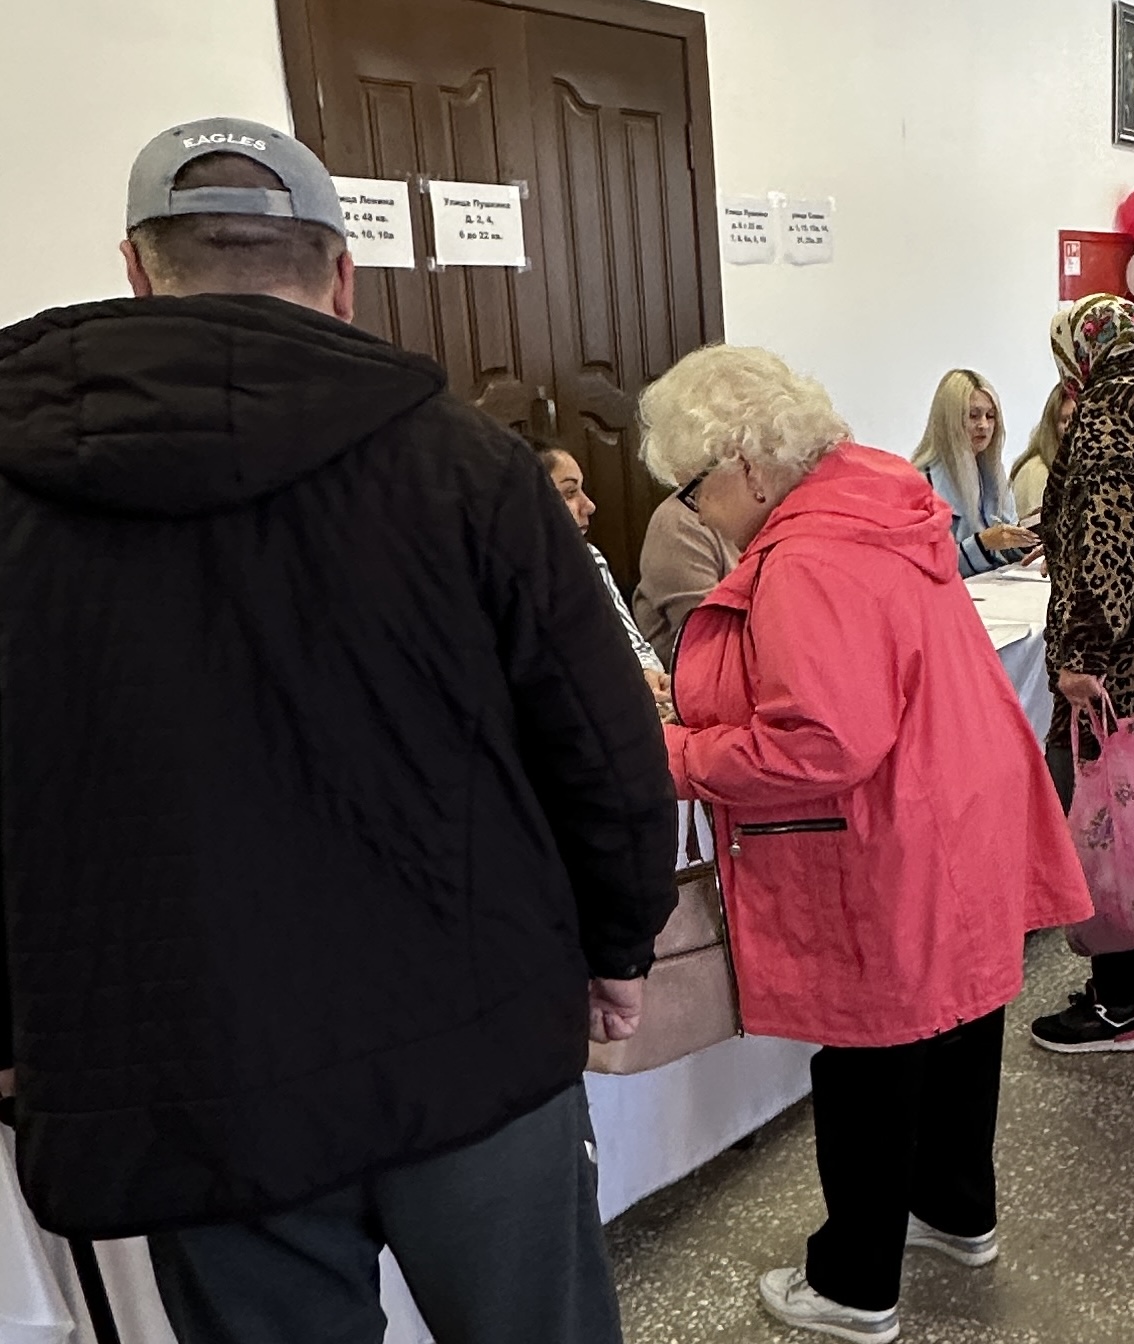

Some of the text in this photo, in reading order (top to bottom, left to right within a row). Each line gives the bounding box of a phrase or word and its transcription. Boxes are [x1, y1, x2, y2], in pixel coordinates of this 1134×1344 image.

[182, 133, 267, 152] EAGLES
[339, 195, 395, 206] ица Ленина
[473, 199, 512, 210] Пушкина
